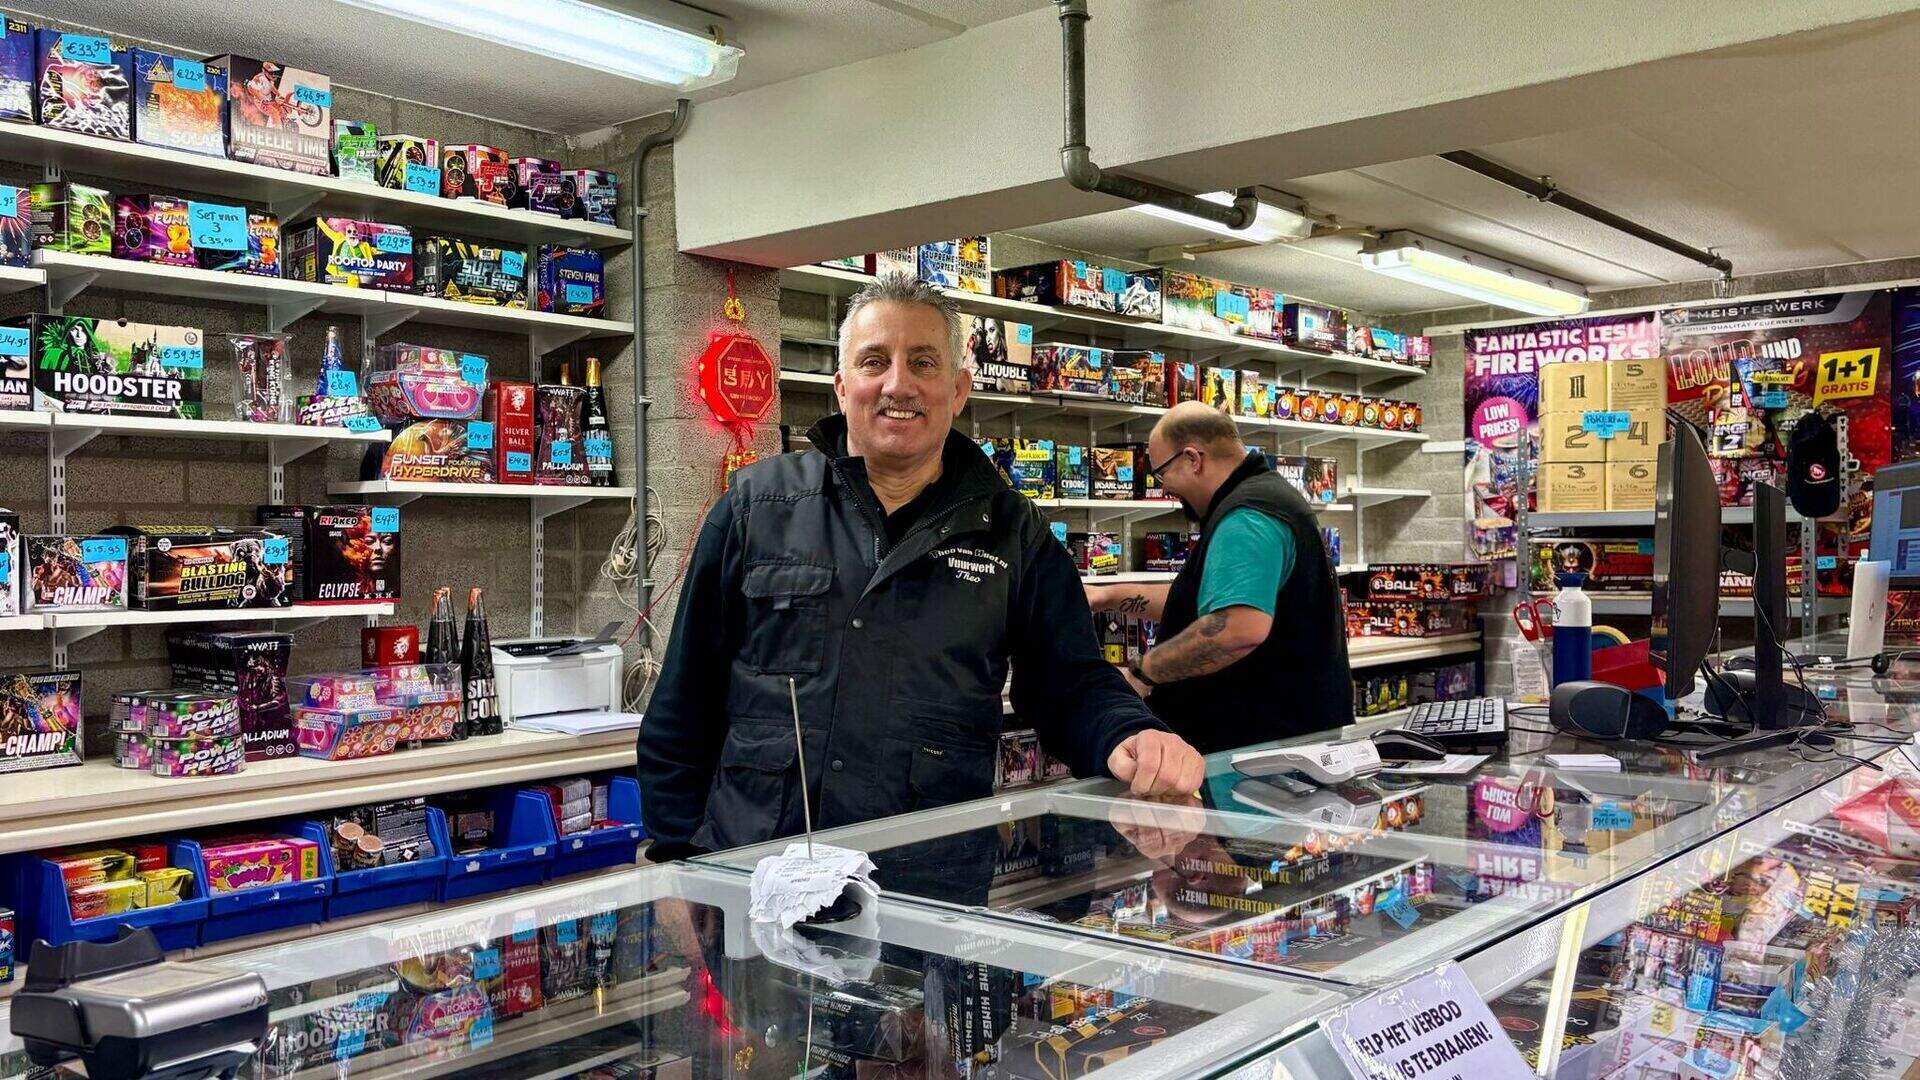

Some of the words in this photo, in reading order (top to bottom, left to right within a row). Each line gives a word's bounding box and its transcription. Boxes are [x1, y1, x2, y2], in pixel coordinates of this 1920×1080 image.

[9, 22, 27, 32] 2311
[235, 128, 293, 152] WHEELIE
[296, 140, 325, 157] TIME
[212, 222, 222, 233] 3
[168, 224, 190, 252] 2
[260, 238, 277, 265] 3
[925, 250, 955, 264] SUPREME
[328, 255, 375, 269] ROOFTOP
[377, 260, 407, 272] PARTY
[932, 262, 955, 272] VORTEX
[958, 260, 987, 271] SUPREME
[559, 269, 584, 280] STEVEN
[1697, 300, 1826, 319] MEISTERWERK
[1755, 317, 1806, 328] FEUERWERK
[1475, 328, 1582, 353] FANTASTIC
[1475, 341, 1650, 377] FIREWORKS
[983, 362, 1028, 380] TROUBLE
[1626, 364, 1644, 377] 5
[1823, 353, 1873, 383] 1+1
[54, 372, 182, 400] HOODSTER
[1820, 380, 1869, 396] GRATIS
[1484, 402, 1509, 421] LOW
[505, 427, 530, 436] SILVER
[1479, 418, 1520, 439] PRICES!
[1627, 421, 1649, 446] 4
[508, 437, 526, 446] BALL
[1565, 425, 1589, 449] 2
[393, 454, 448, 466] SUNSET
[542, 462, 584, 471] PALLADIUM
[391, 467, 481, 478] HYPERDRIVE
[1567, 465, 1586, 479] 3
[1629, 464, 1649, 479] 6
[1061, 480, 1085, 489] CYBORG
[957, 547, 973, 556] van
[181, 561, 247, 578] BLASTING
[948, 557, 996, 575] Vuurwerk
[180, 572, 246, 594] BULLDOG
[955, 570, 981, 583] Theo
[1374, 578, 1418, 591] 8-BALL
[53, 587, 111, 605] CHAMP!
[319, 583, 362, 599] ECLYPSE
[6, 731, 67, 756] CHAMP!
[243, 728, 290, 743] ALLADIUM
[1190, 859, 1214, 873] ZENA
[1185, 889, 1209, 905] ZENA
[1384, 1021, 1410, 1049] HET
[1410, 1000, 1463, 1038] VERBOD
[1416, 1052, 1434, 1073] TE
[1432, 1020, 1494, 1067] DRAAIEN!
